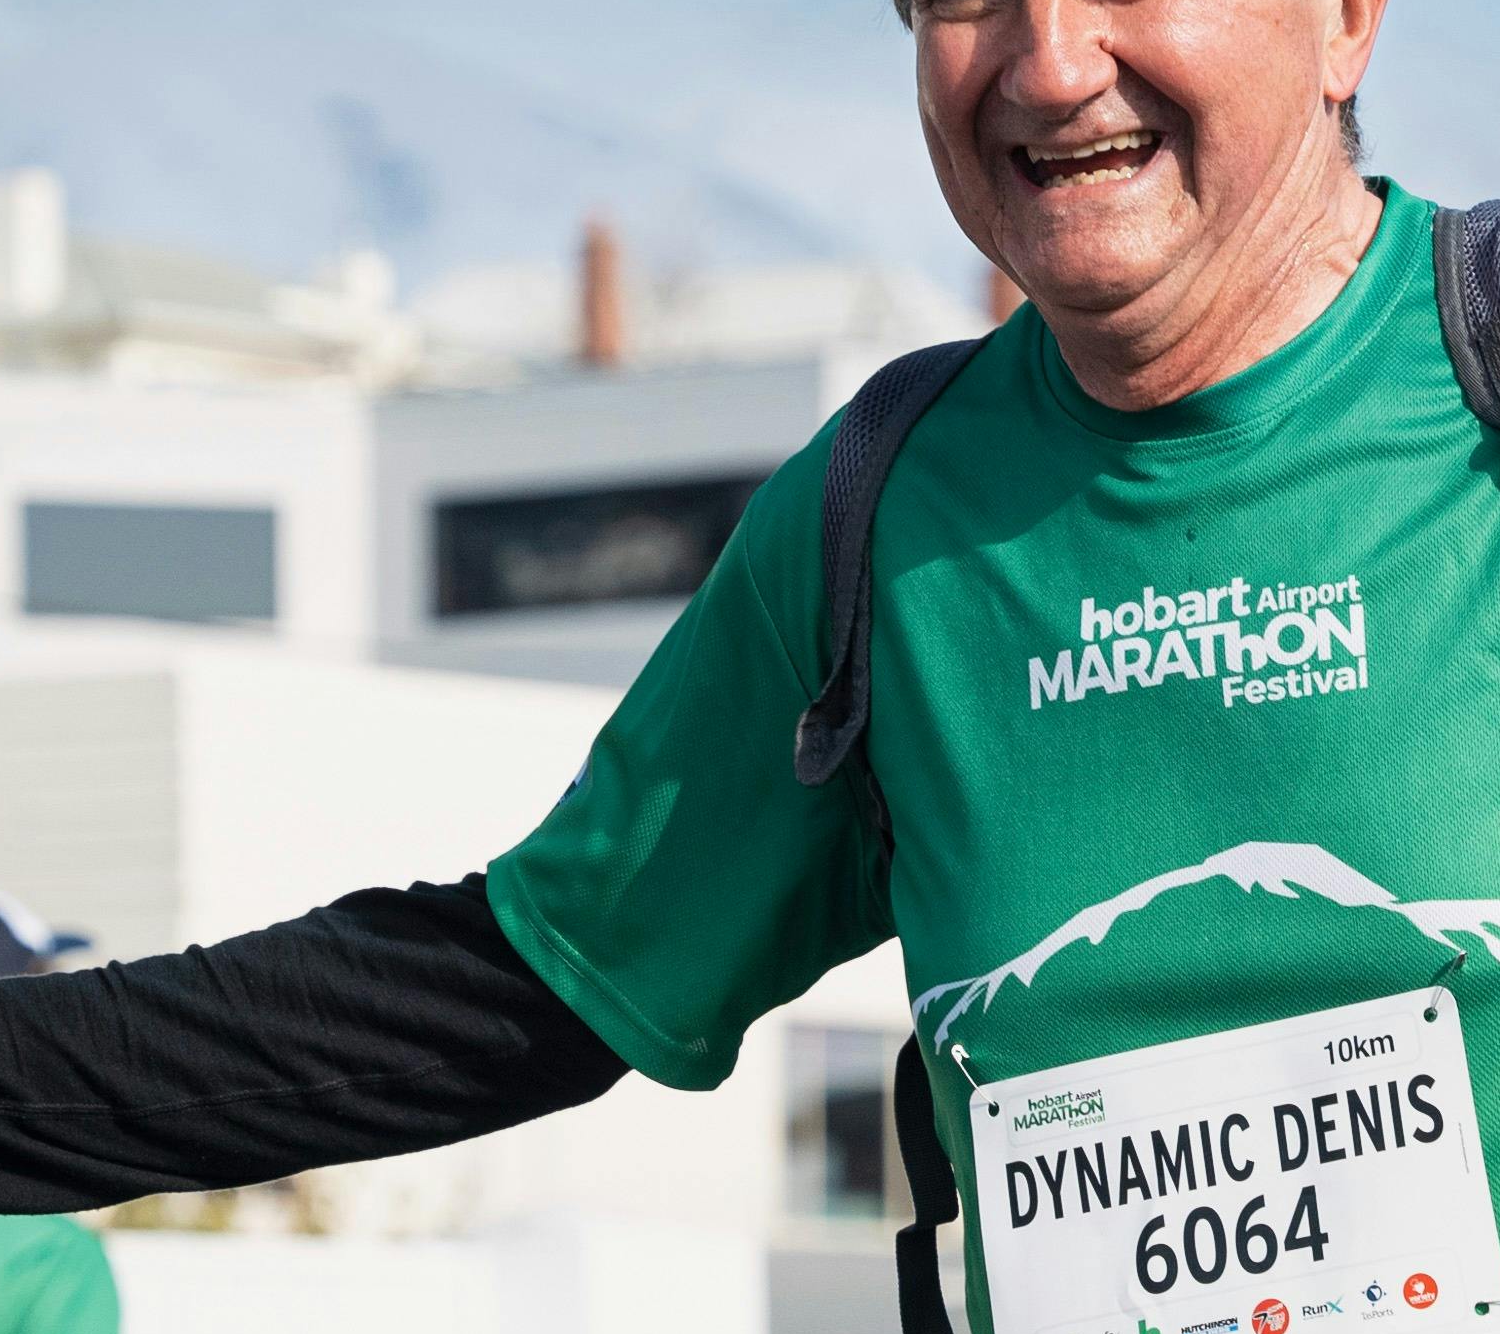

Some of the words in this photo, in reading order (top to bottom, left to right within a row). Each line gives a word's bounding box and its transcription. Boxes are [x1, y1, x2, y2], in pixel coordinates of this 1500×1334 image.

[1080, 576, 1251, 642] hobart
[1256, 573, 1363, 615] Airport
[1222, 657, 1369, 708] Festival
[1323, 1031, 1396, 1066] 10km
[1028, 1091, 1073, 1111] hobart
[1075, 1089, 1101, 1102] Airport
[1068, 1113, 1105, 1128] Festival
[1005, 1113, 1254, 1229] DYNAMIC
[1273, 1073, 1446, 1173] DENIS
[1134, 1185, 1330, 1295] 6064
[1302, 1294, 1344, 1317] RunX
[1181, 1317, 1238, 1334] HUTCHINSON
